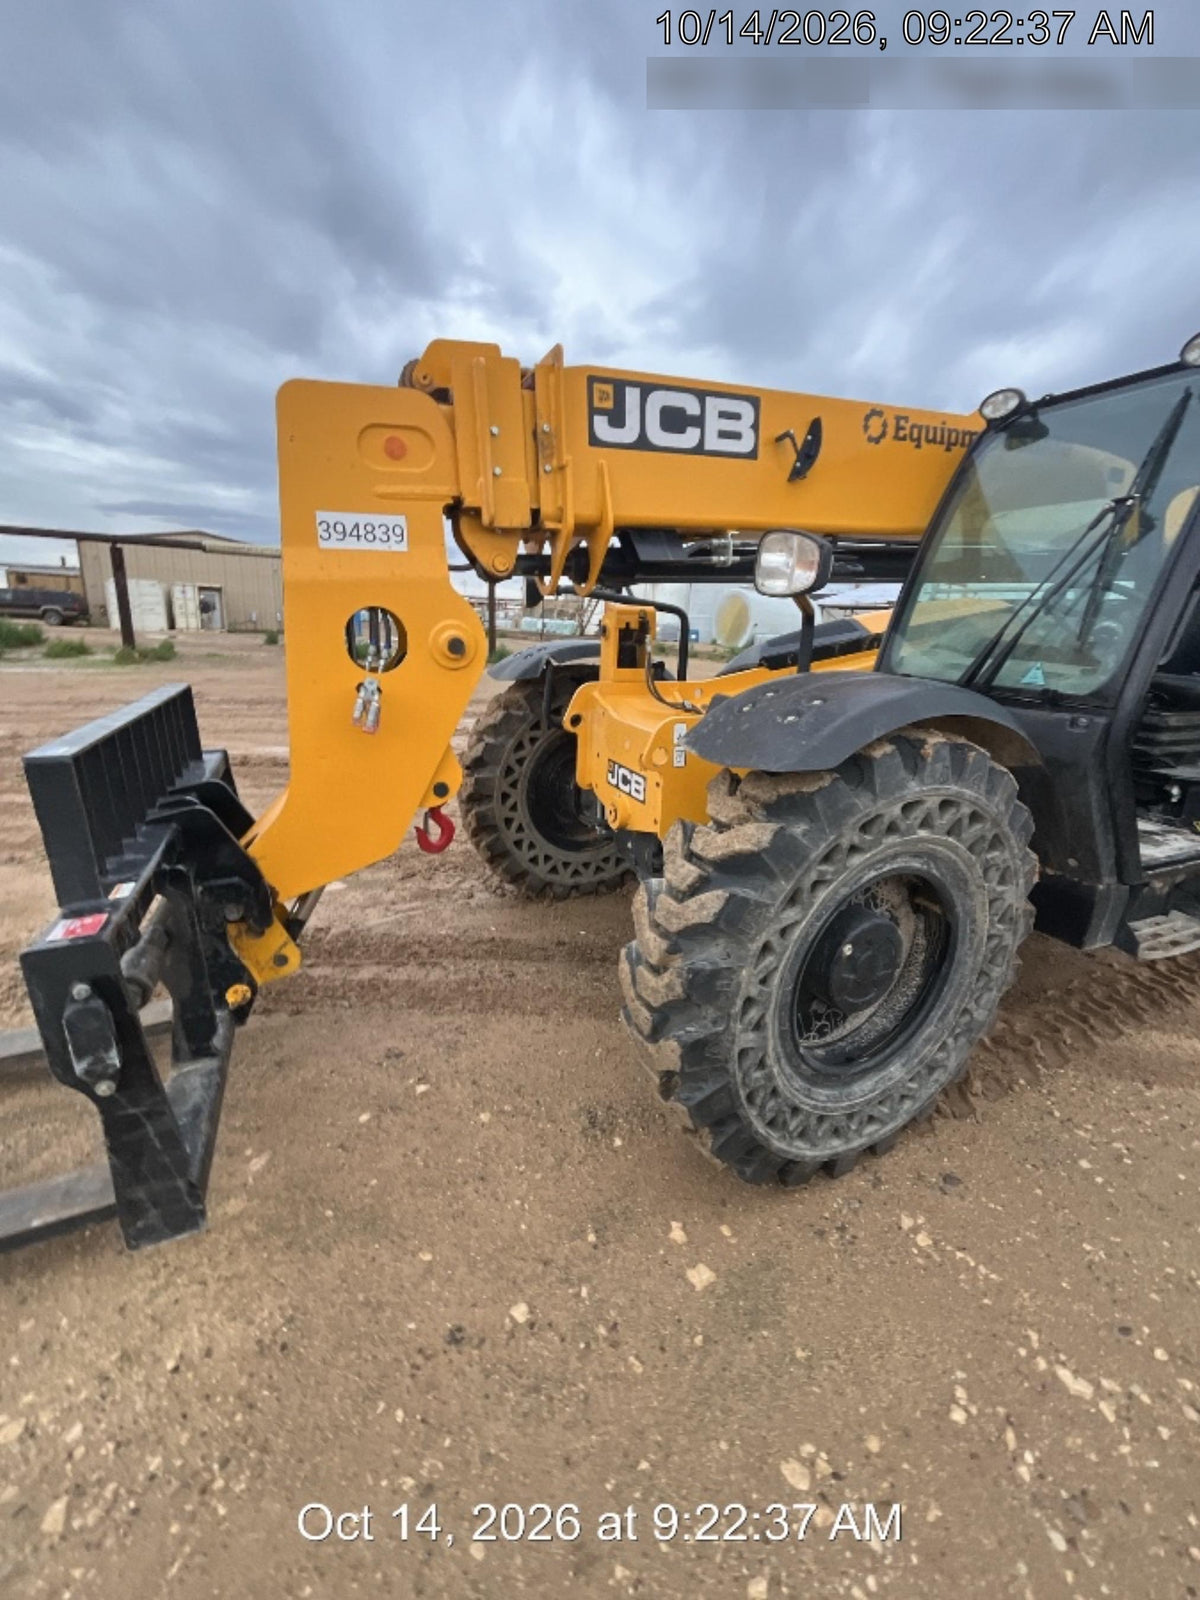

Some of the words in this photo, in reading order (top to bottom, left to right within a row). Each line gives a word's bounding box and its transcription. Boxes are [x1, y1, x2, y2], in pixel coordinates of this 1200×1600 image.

[593, 386, 756, 454] JCB
[317, 520, 405, 545] 394839
[607, 763, 646, 802] JCB
